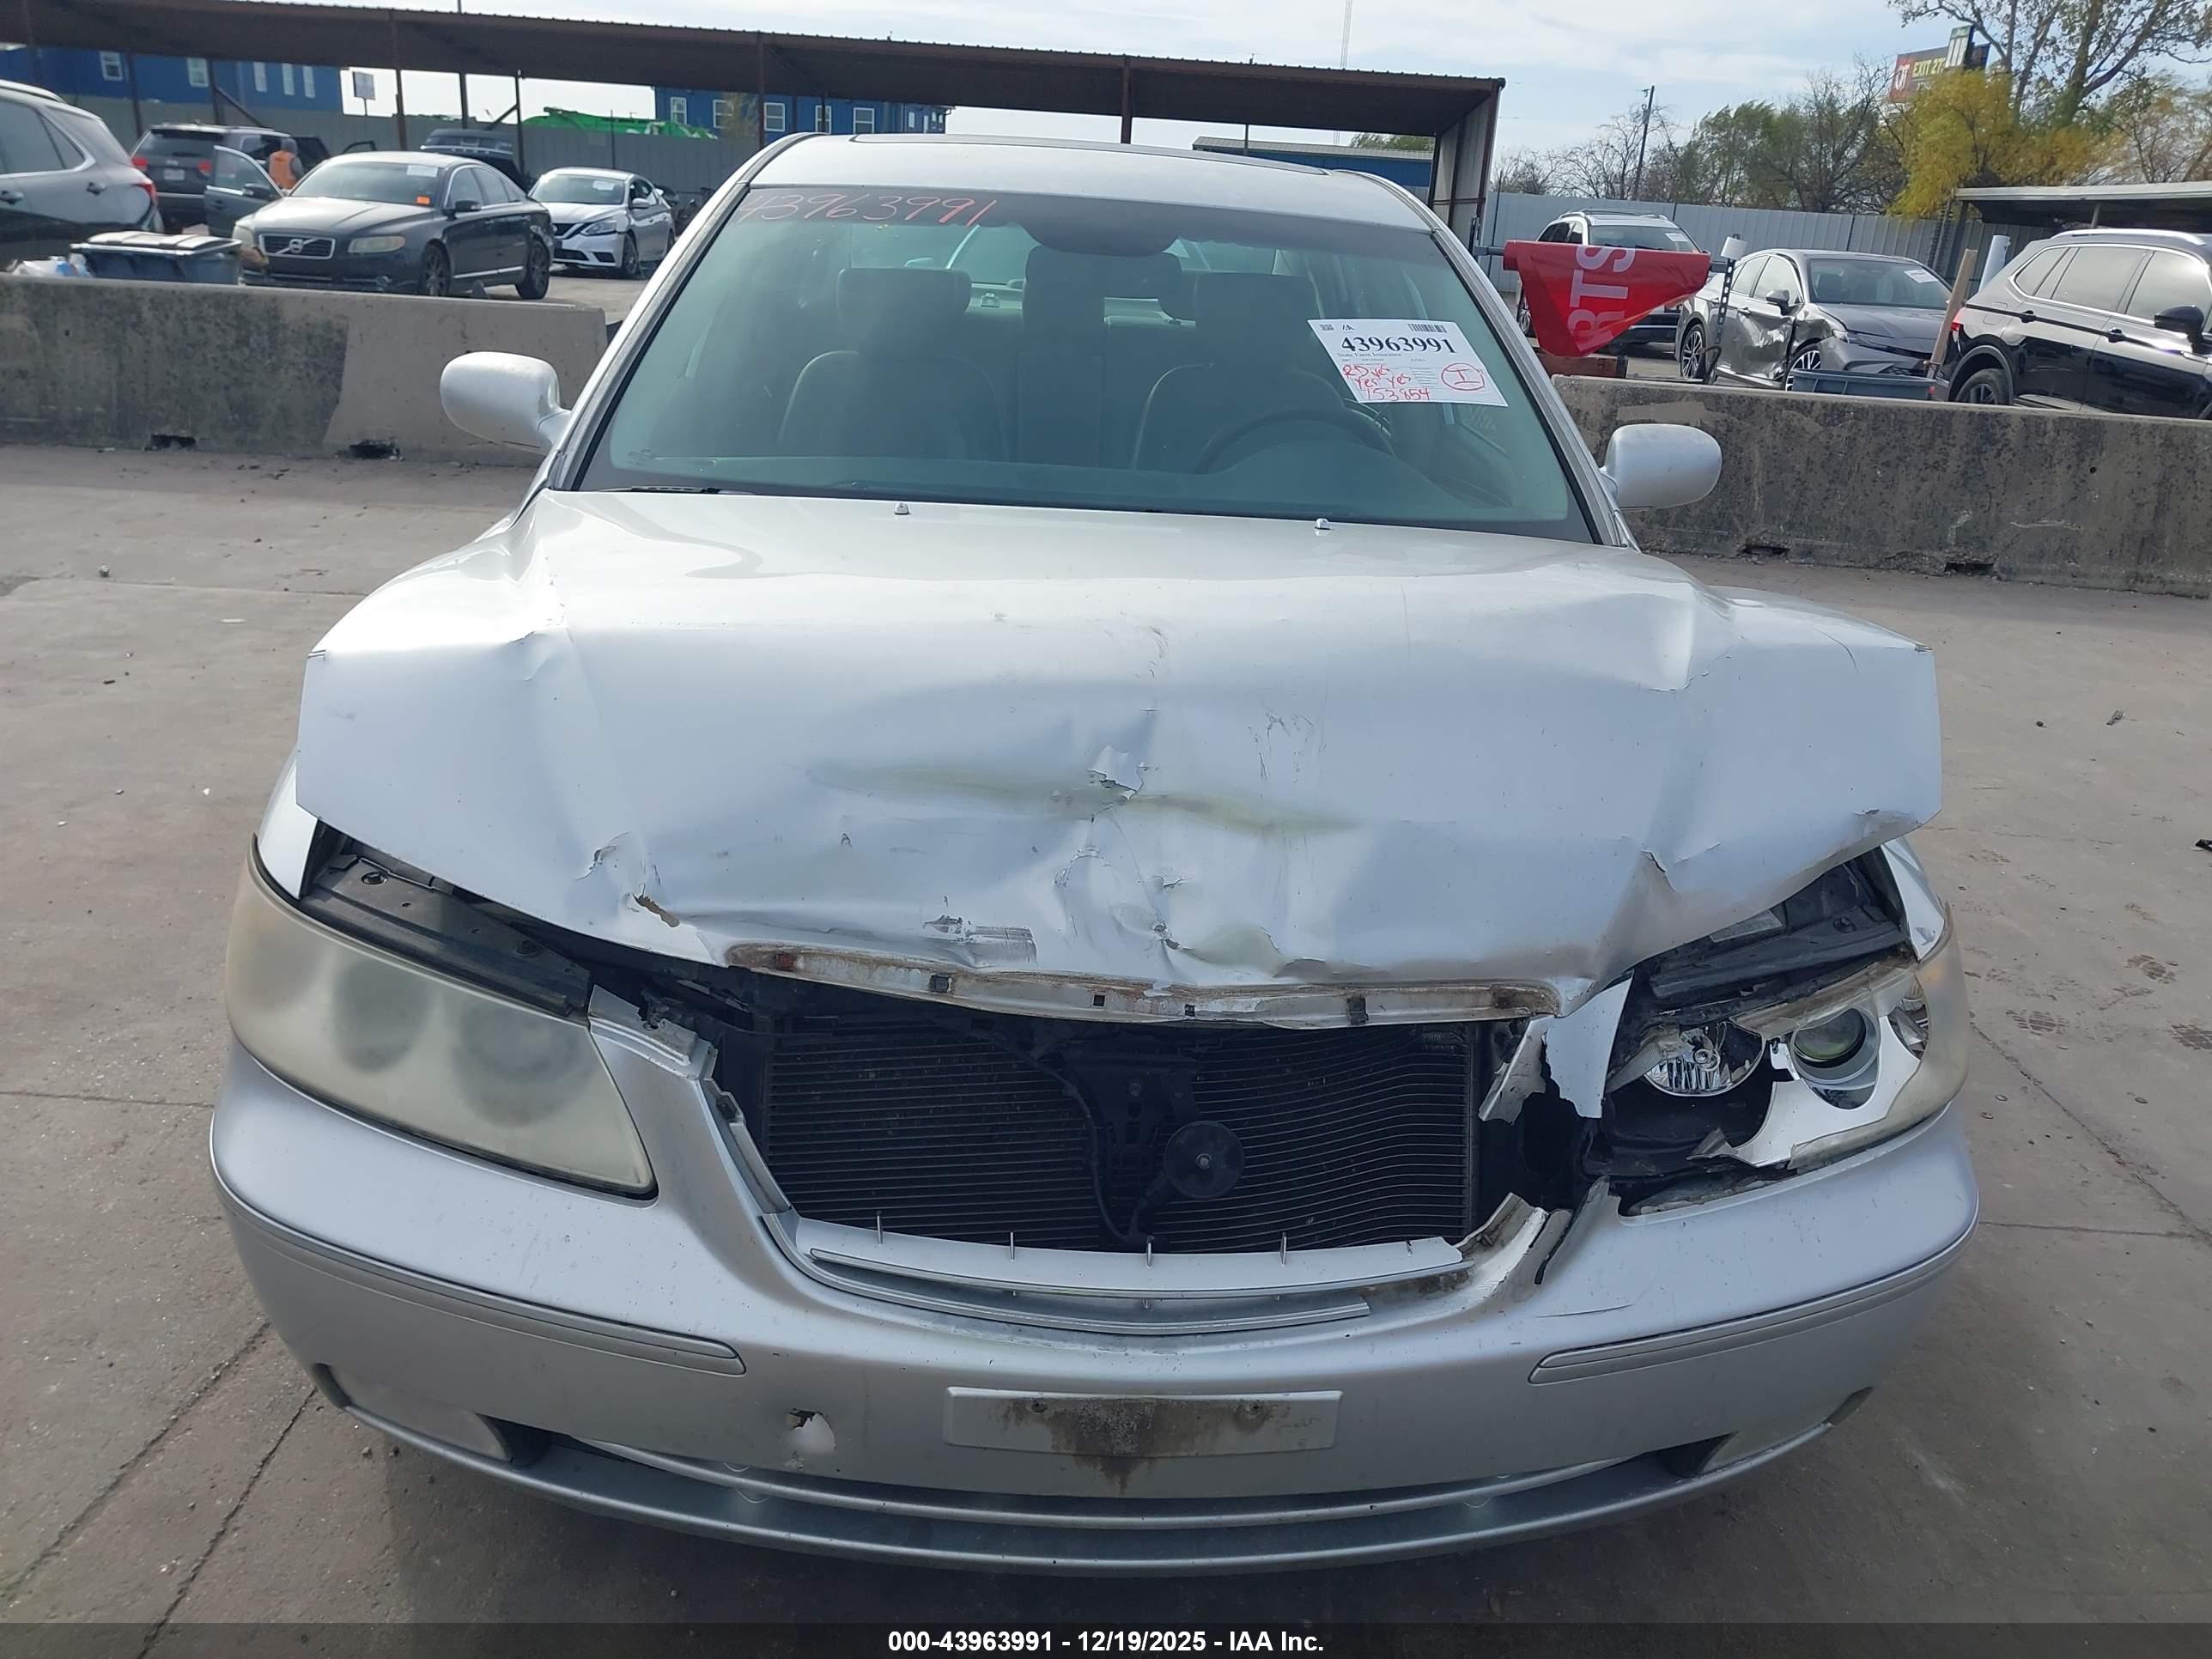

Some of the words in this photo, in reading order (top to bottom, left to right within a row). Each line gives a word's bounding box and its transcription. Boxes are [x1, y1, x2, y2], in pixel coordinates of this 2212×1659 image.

[1912, 59, 1932, 77] EXIT
[738, 192, 998, 228] 43963991
[1341, 336, 1458, 354] 43963991
